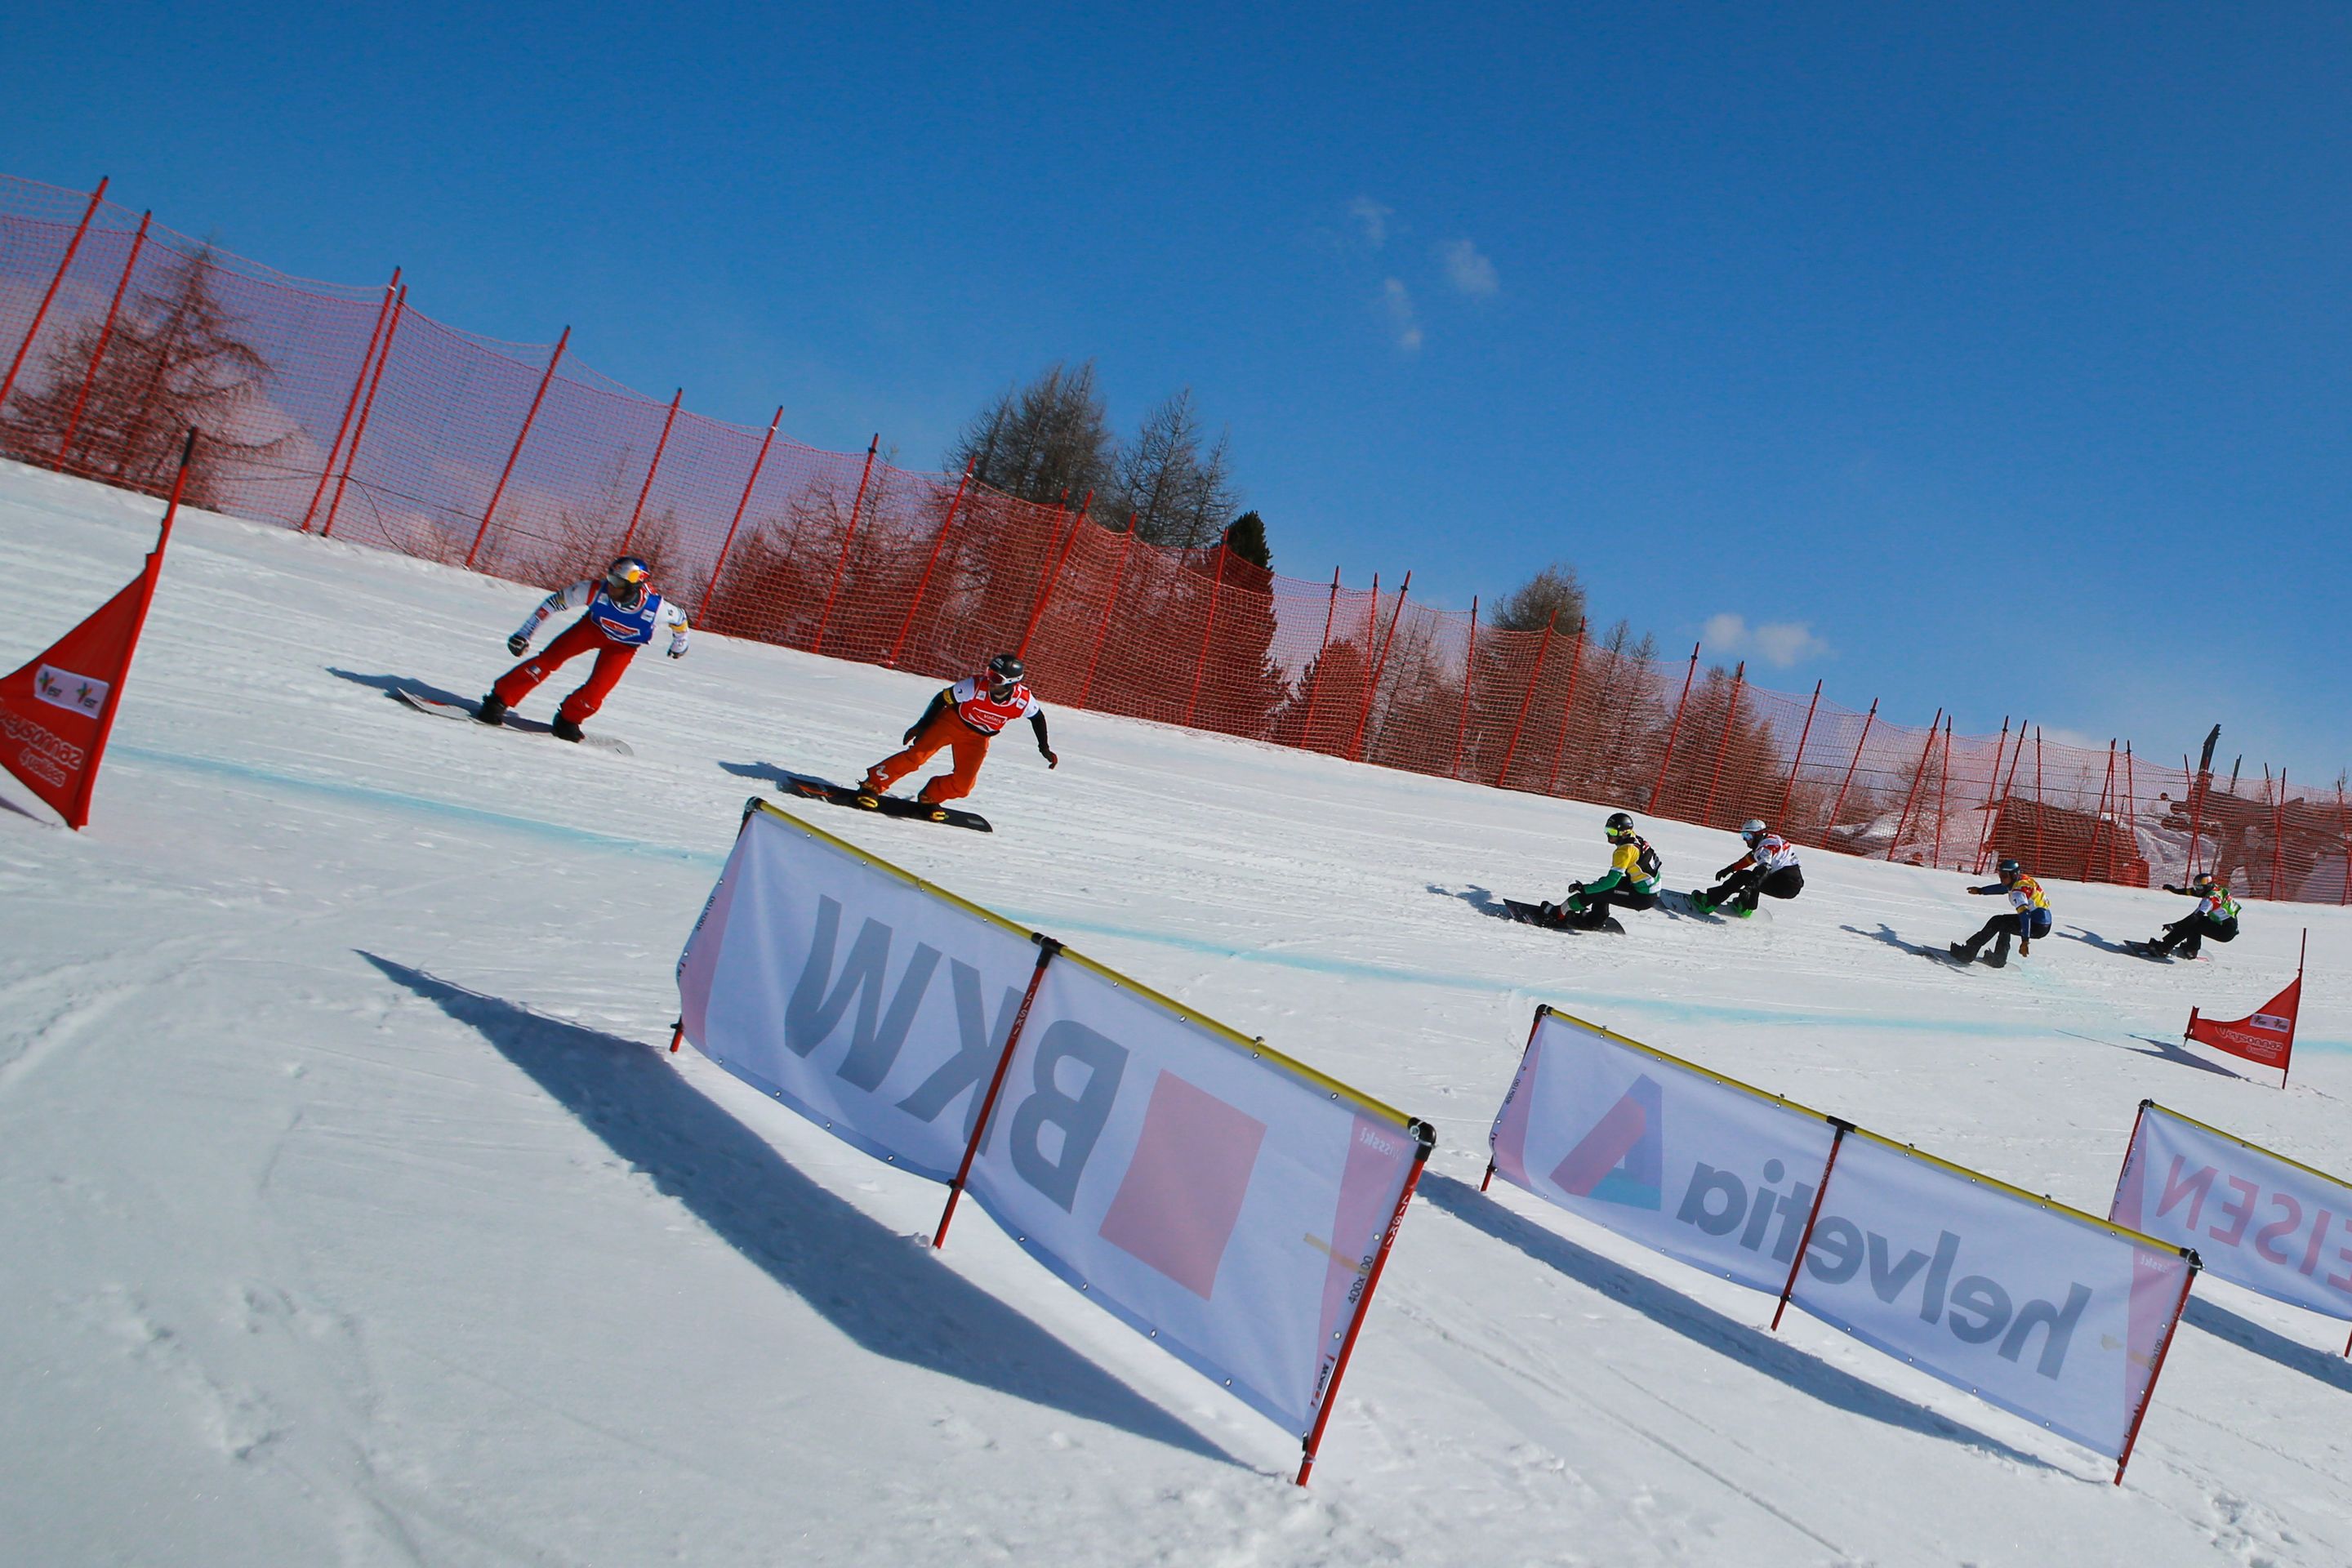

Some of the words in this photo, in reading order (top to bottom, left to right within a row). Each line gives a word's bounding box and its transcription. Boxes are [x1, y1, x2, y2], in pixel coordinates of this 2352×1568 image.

[1013, 991, 1033, 1036] LISKI
[2215, 1026, 2283, 1052] Veysonnaz
[1386, 1194, 1409, 1246] LISKI
[1348, 1255, 1374, 1305] 400x100
